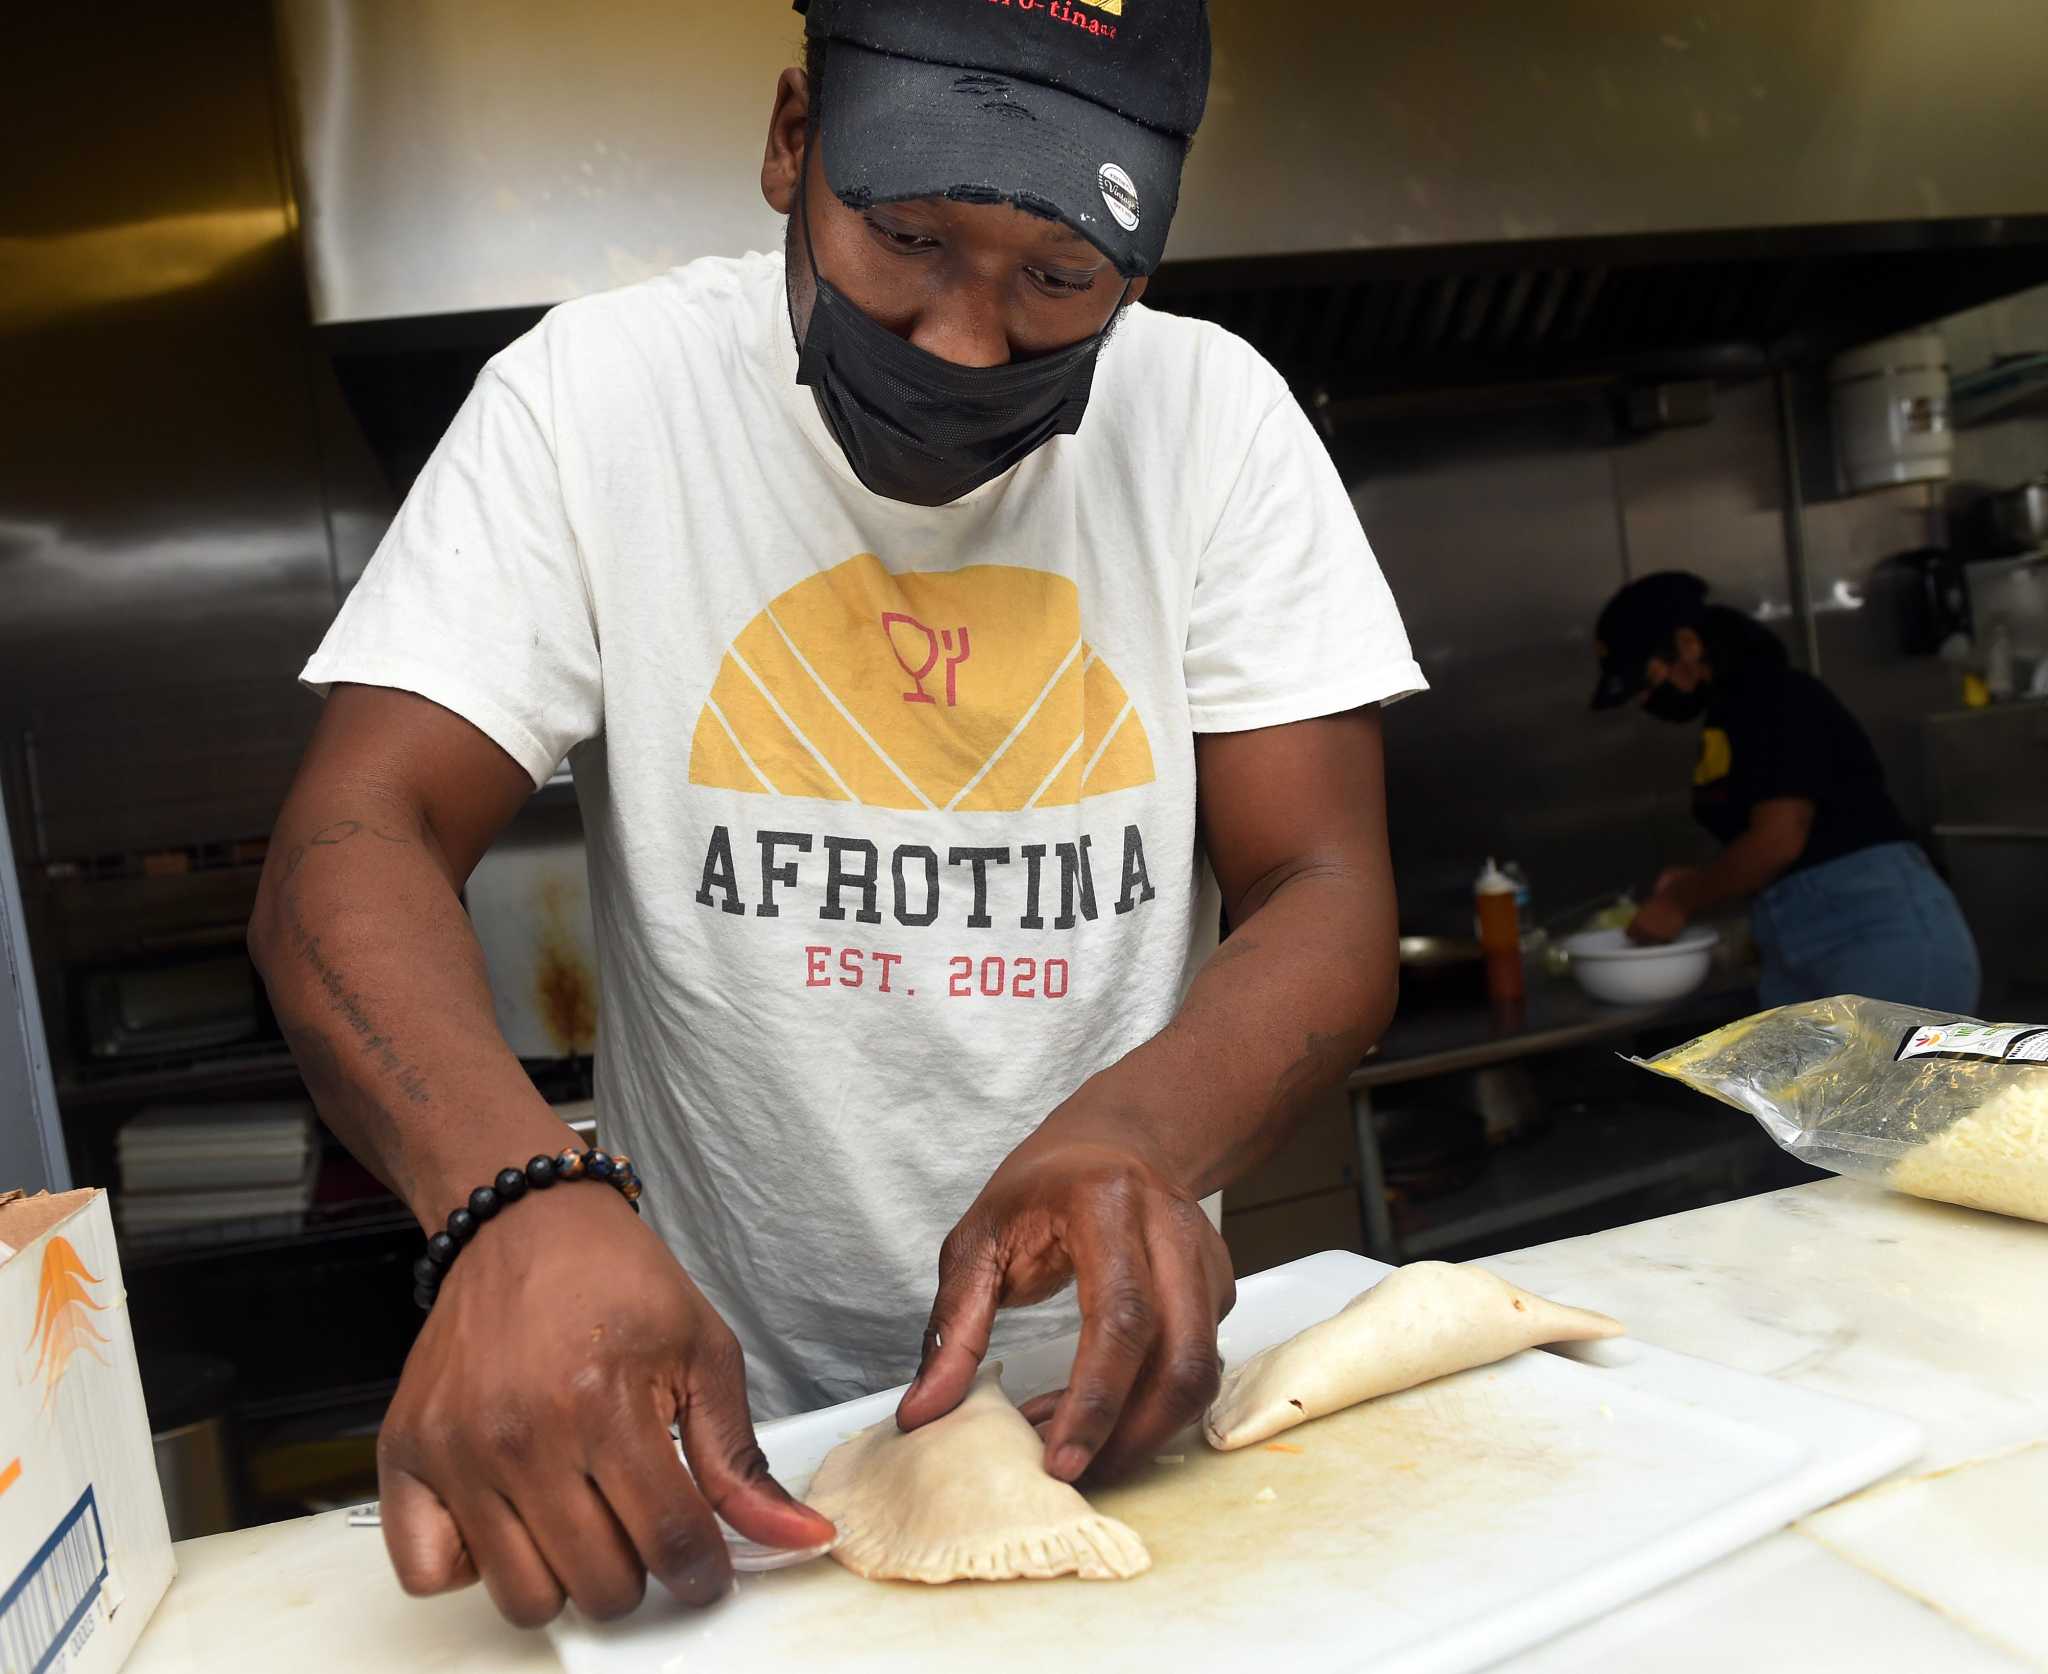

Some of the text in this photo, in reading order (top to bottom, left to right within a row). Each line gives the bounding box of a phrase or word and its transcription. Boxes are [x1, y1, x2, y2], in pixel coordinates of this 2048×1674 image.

[988, 0, 1101, 35] o-tina
[695, 824, 1156, 931] AFROTINA
[804, 945, 1070, 999] EST. 2020
